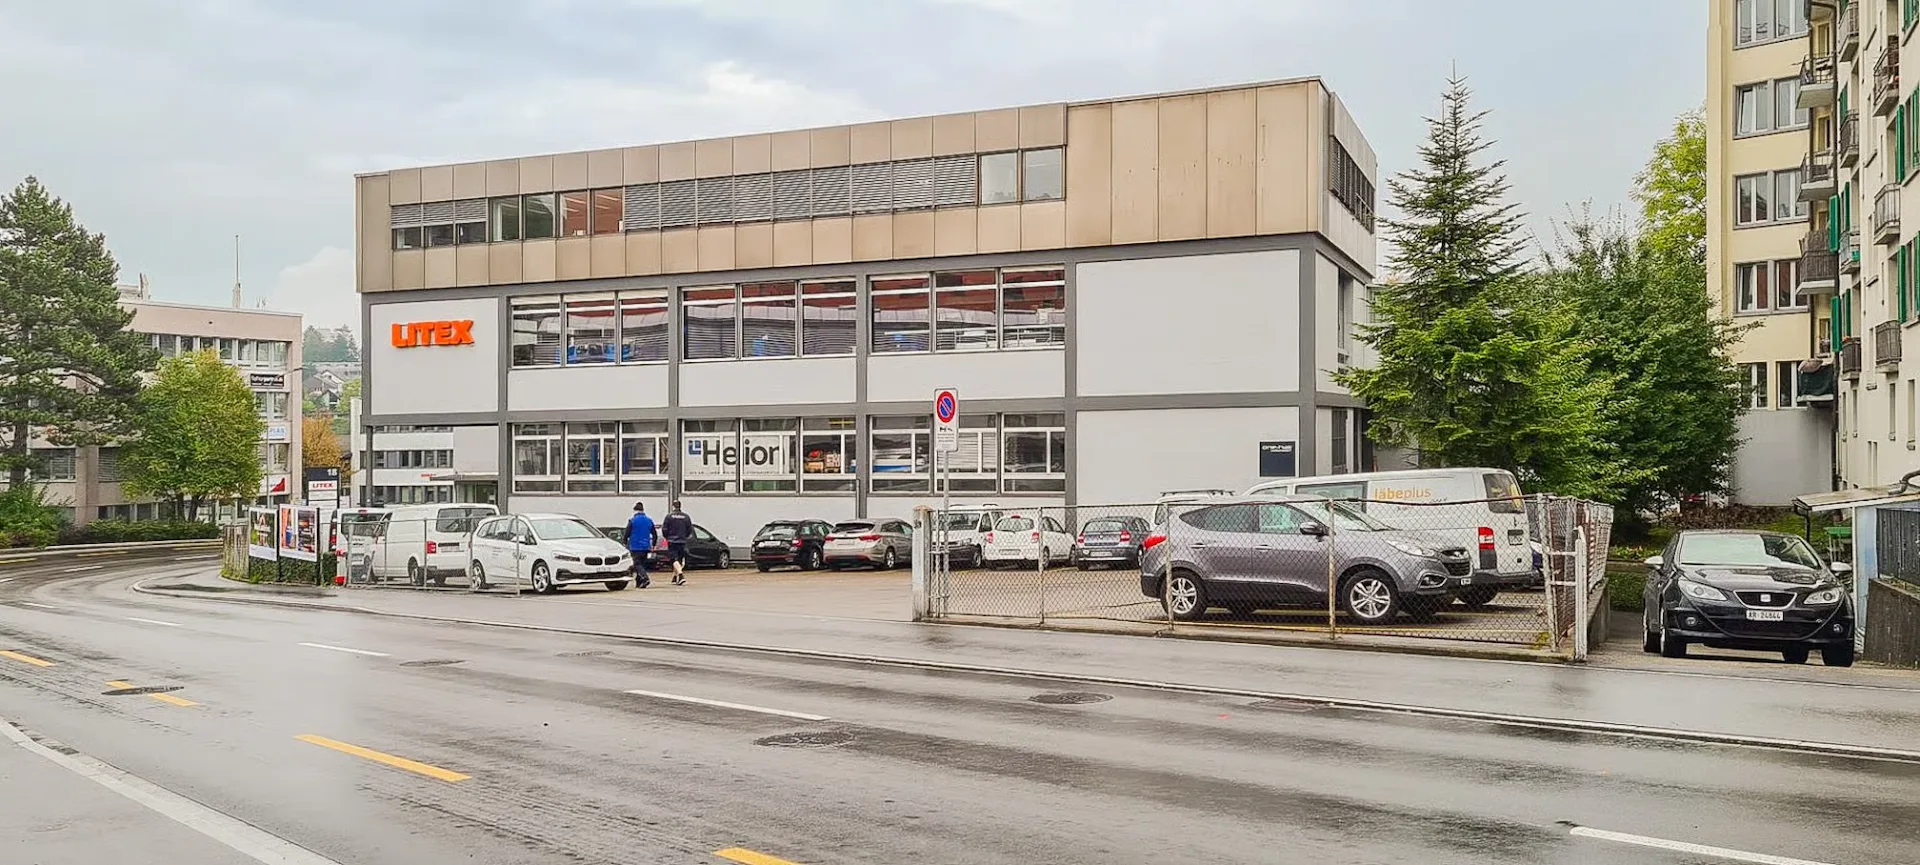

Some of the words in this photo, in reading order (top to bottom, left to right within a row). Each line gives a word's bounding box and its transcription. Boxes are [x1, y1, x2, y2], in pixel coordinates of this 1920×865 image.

[392, 320, 474, 347] LITEX
[702, 438, 785, 465] Heion
[1374, 485, 1432, 500] läbeplus
